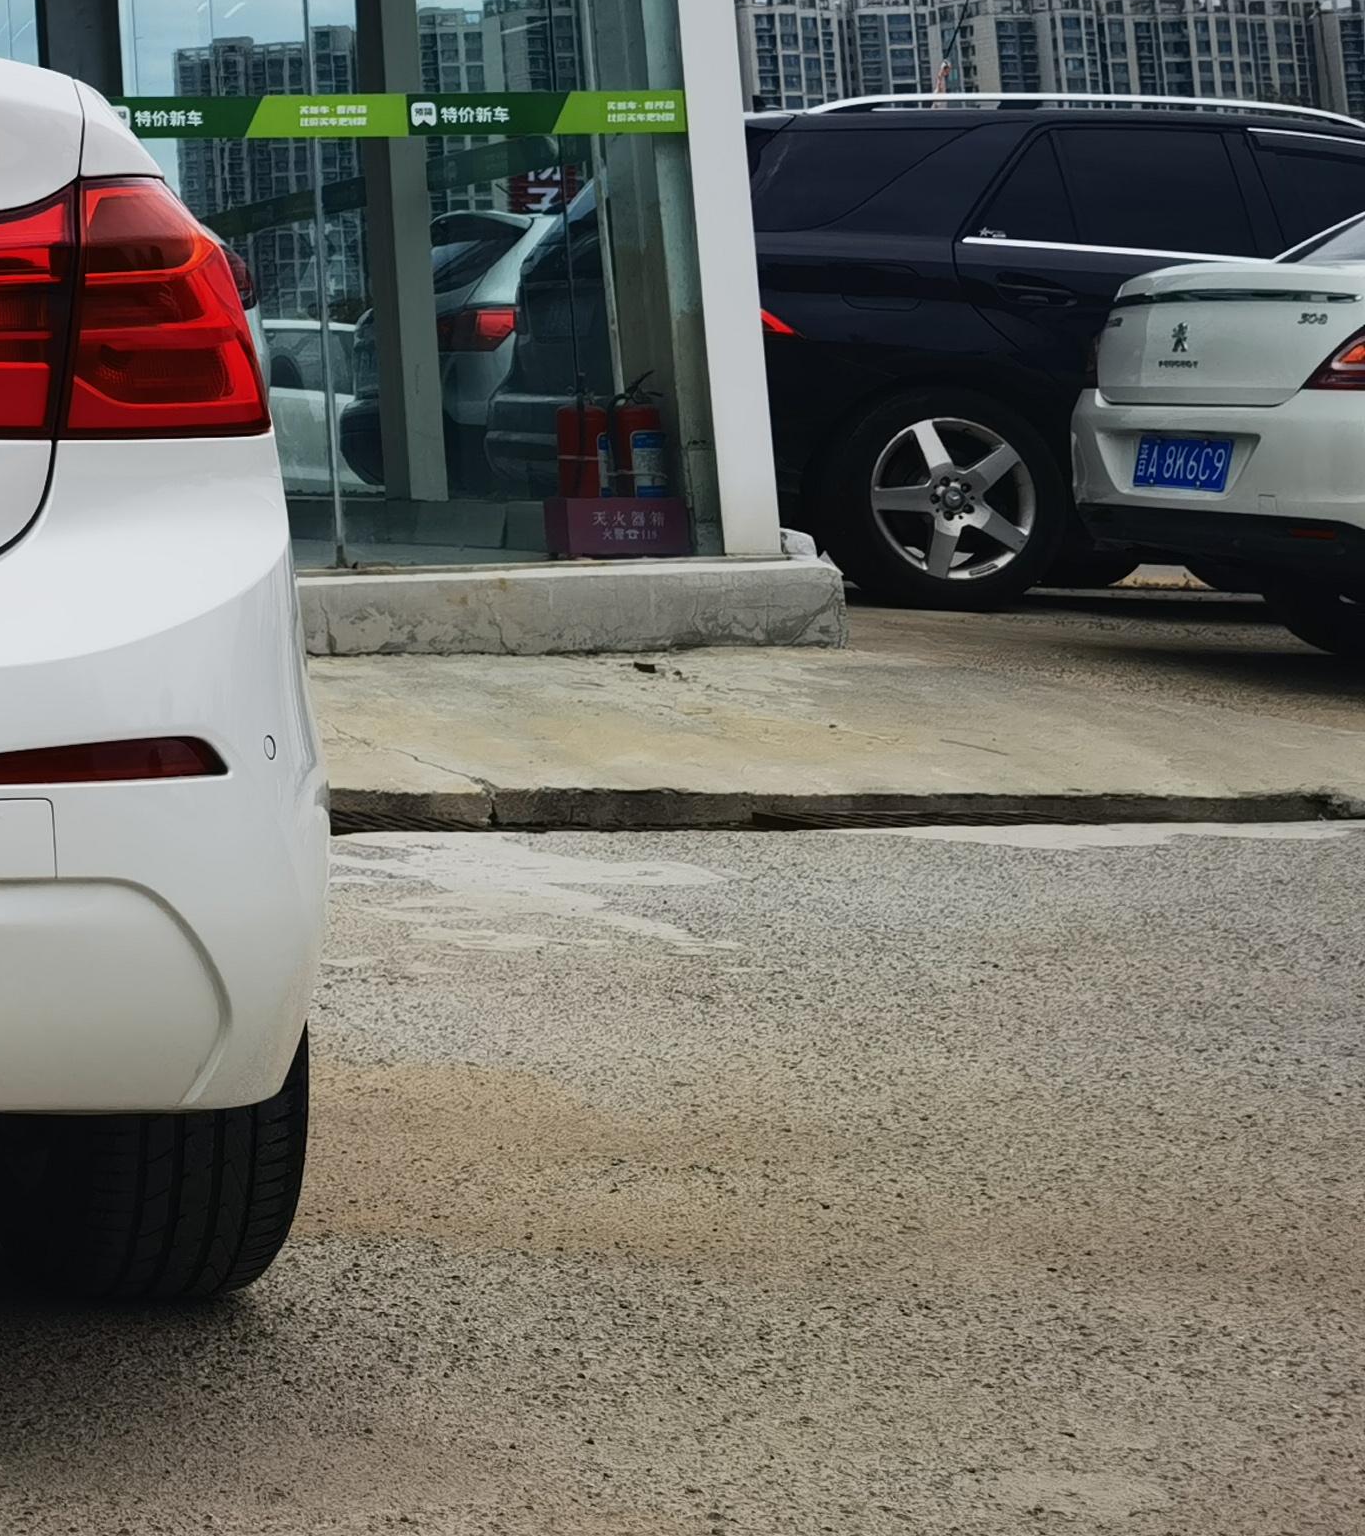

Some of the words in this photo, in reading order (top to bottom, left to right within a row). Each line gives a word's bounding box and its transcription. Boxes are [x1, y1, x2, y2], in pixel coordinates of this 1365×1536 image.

[135, 110, 204, 127] 特价新车
[441, 107, 510, 124] 特价新车
